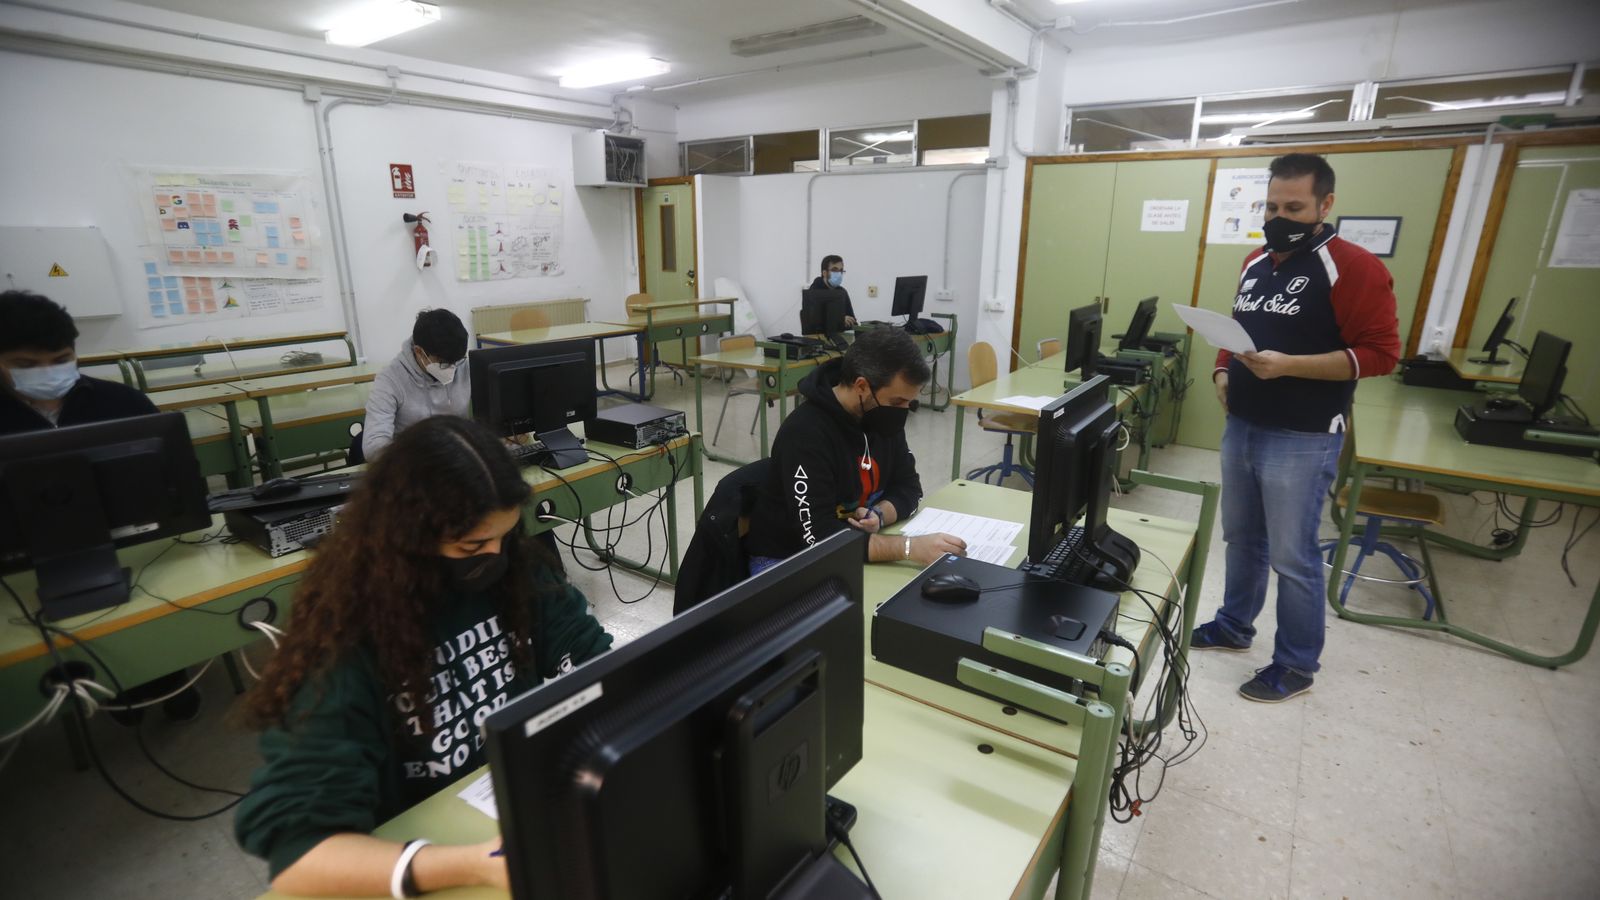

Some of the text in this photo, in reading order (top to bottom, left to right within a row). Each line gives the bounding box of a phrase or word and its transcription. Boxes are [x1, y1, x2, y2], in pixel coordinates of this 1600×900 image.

[1290, 279, 1305, 291] F
[1233, 293, 1300, 316] West Side
